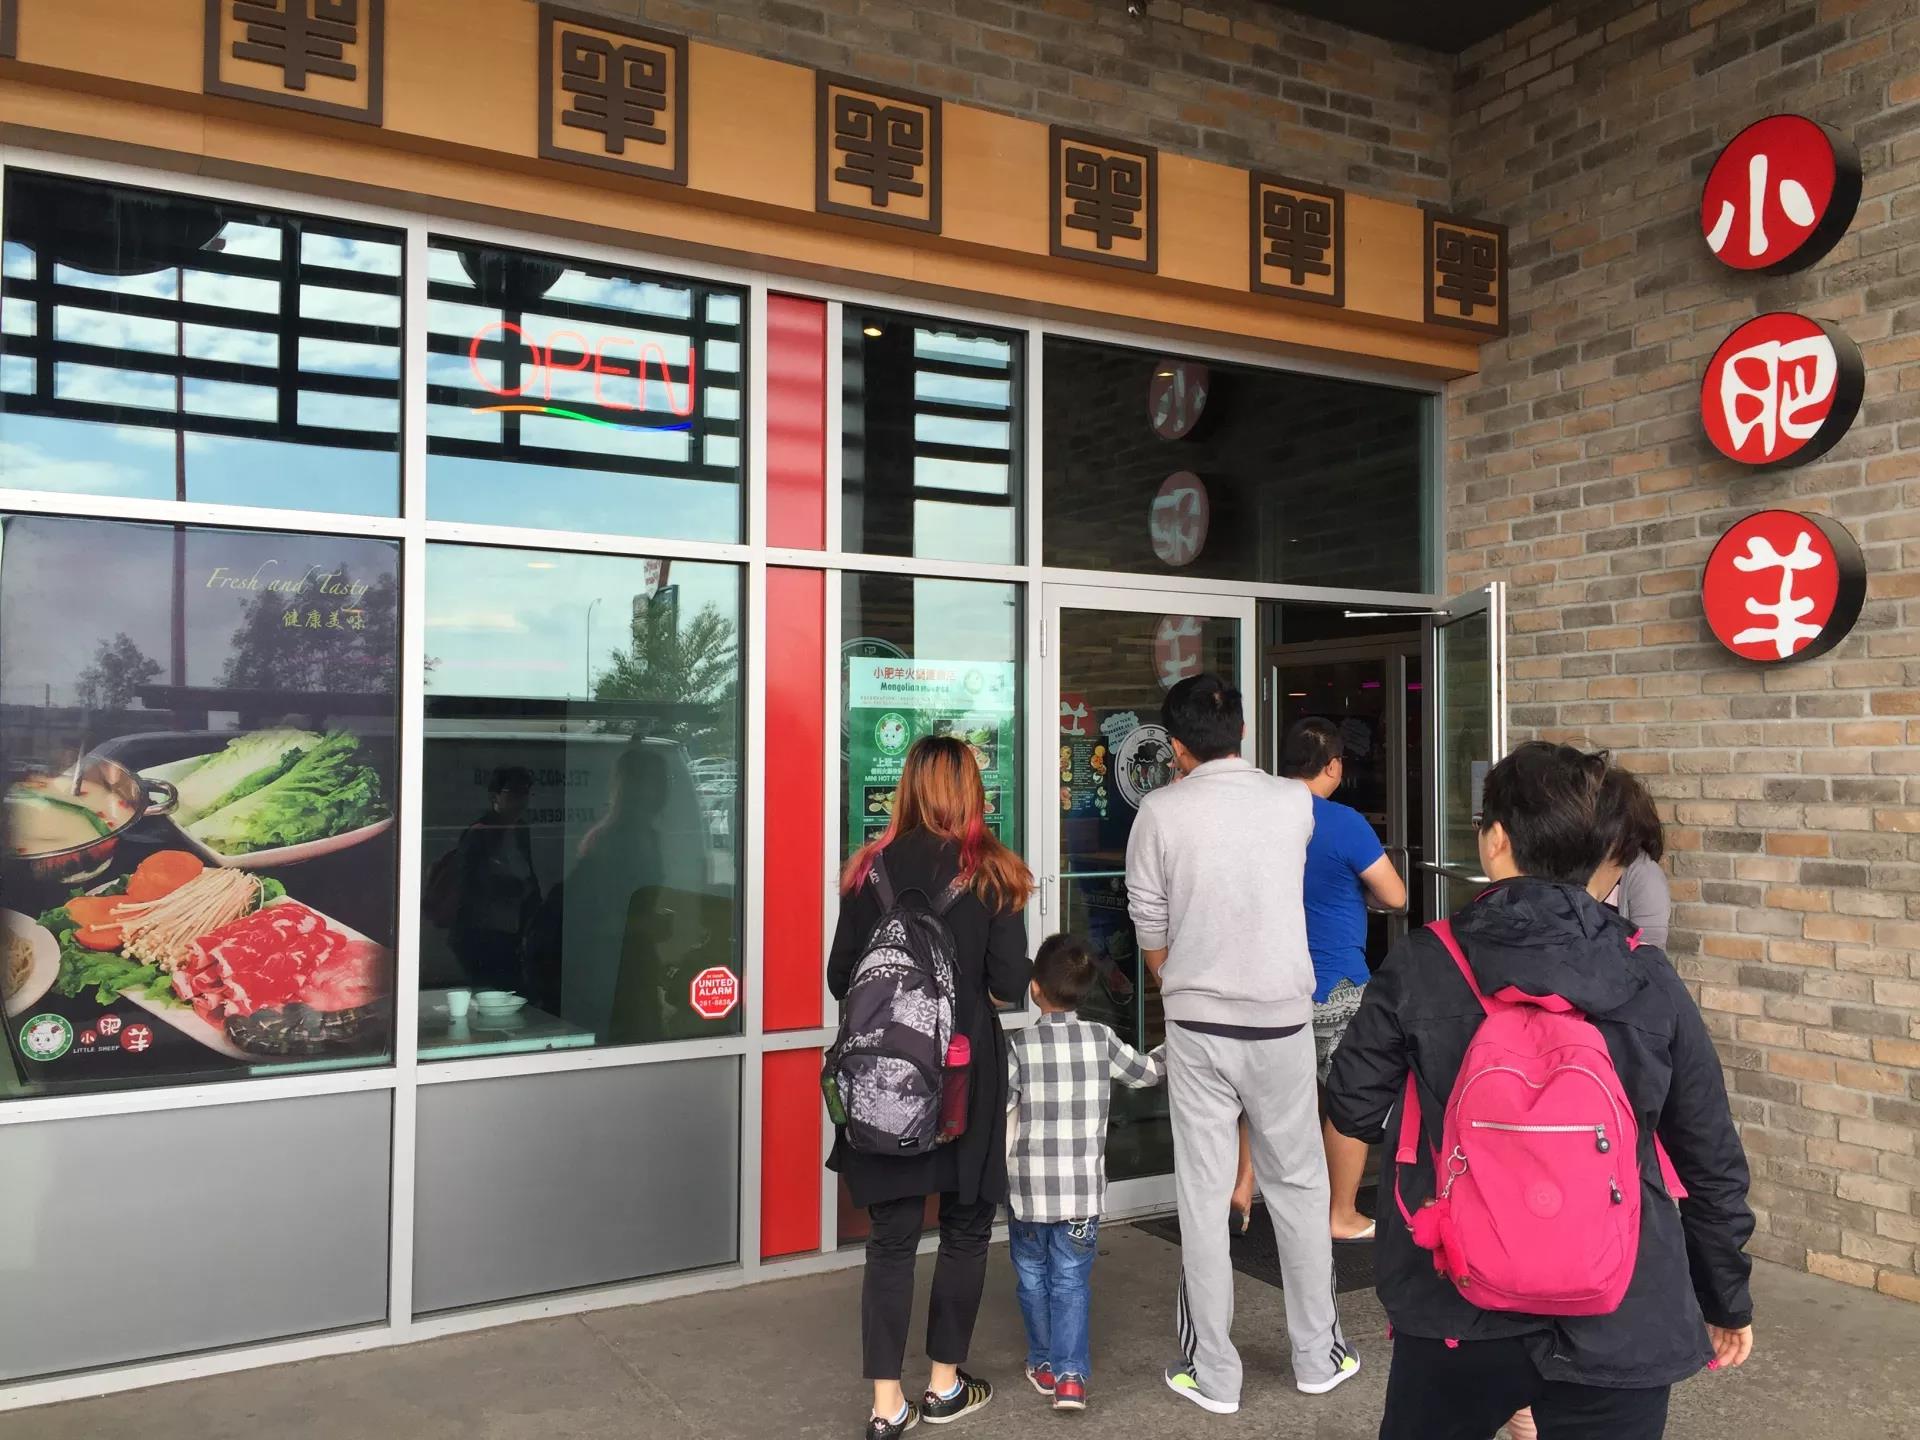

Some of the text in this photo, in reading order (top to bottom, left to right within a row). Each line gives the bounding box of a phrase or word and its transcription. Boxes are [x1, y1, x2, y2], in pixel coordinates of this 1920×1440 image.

[469, 321, 695, 416] OPEN
[206, 559, 369, 612] Fresh and Tasty
[699, 978, 733, 987] UNITED
[699, 987, 733, 996] ALARM
